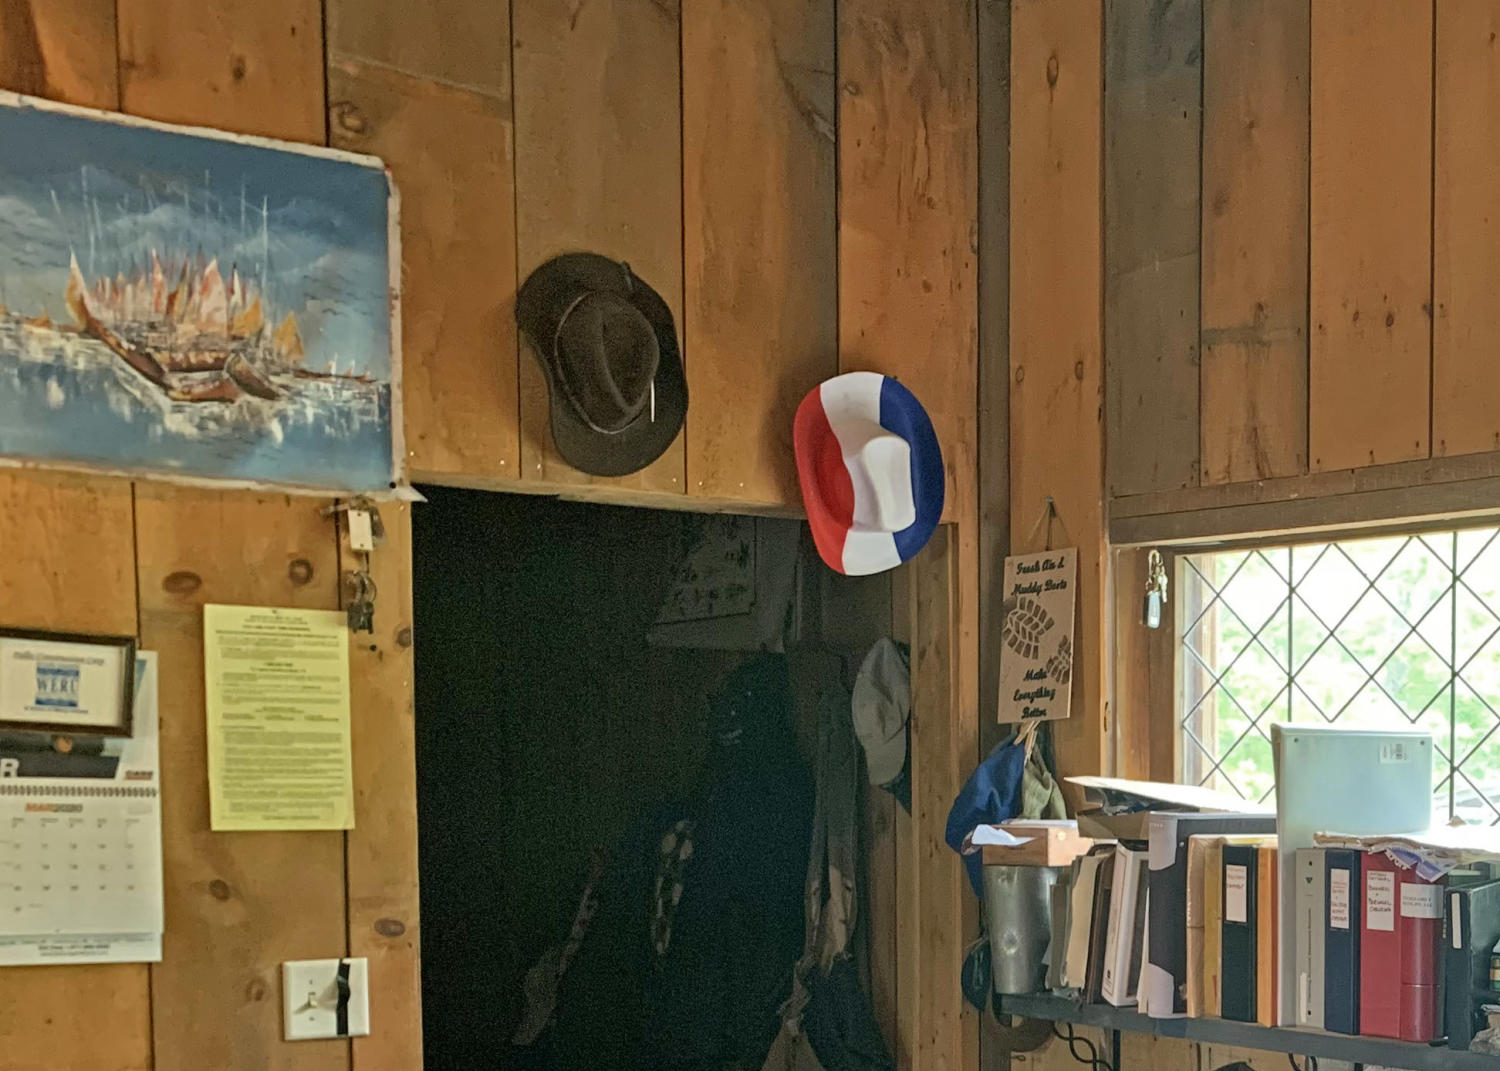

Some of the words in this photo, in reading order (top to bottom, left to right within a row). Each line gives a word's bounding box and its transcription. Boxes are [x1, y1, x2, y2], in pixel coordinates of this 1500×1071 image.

[1016, 560, 1040, 575] Fresh
[1011, 581, 1043, 596] Muddy
[1044, 579, 1067, 591] Boots
[1013, 686, 1056, 704] Everything
[1021, 706, 1047, 720] Better
